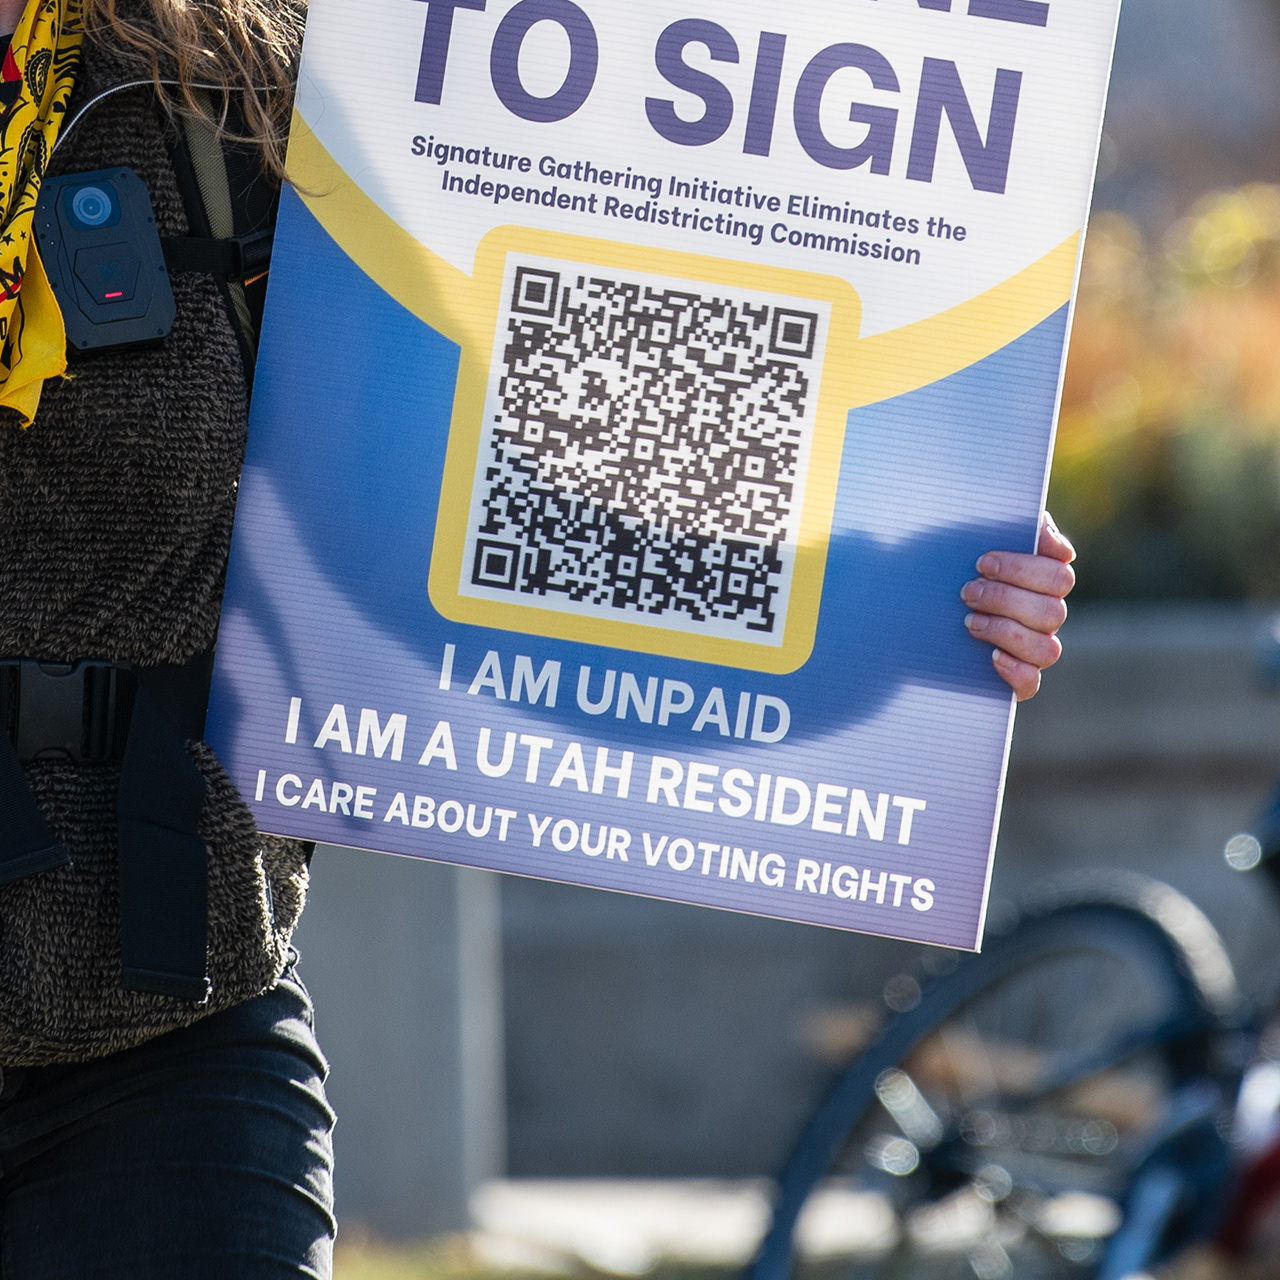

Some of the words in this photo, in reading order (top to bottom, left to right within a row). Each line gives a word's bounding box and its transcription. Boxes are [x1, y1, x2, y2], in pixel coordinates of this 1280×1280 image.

[645, 19, 1022, 194] SIGN
[410, 135, 532, 173] Signature
[538, 155, 663, 199] Gathering
[668, 175, 781, 212] Initiative
[786, 194, 921, 234] Eliminates
[926, 216, 967, 242] the
[441, 170, 598, 214] Independent
[603, 195, 764, 246] Redistricting
[770, 222, 921, 265] Commission
[438, 643, 455, 691] I
[466, 650, 560, 707] AM
[576, 665, 791, 744] UNPAID
[284, 696, 302, 745] I
[313, 703, 407, 762] AM
[418, 720, 458, 771] A
[476, 726, 633, 799] UTAH
[646, 756, 927, 846] RESIDENT
[254, 769, 267, 802] I
[275, 773, 378, 820] CARE
[383, 791, 518, 842] ABOUT
[527, 812, 632, 863] YOUR
[641, 831, 787, 888] VOTING
[793, 857, 936, 912] RIGHTS
